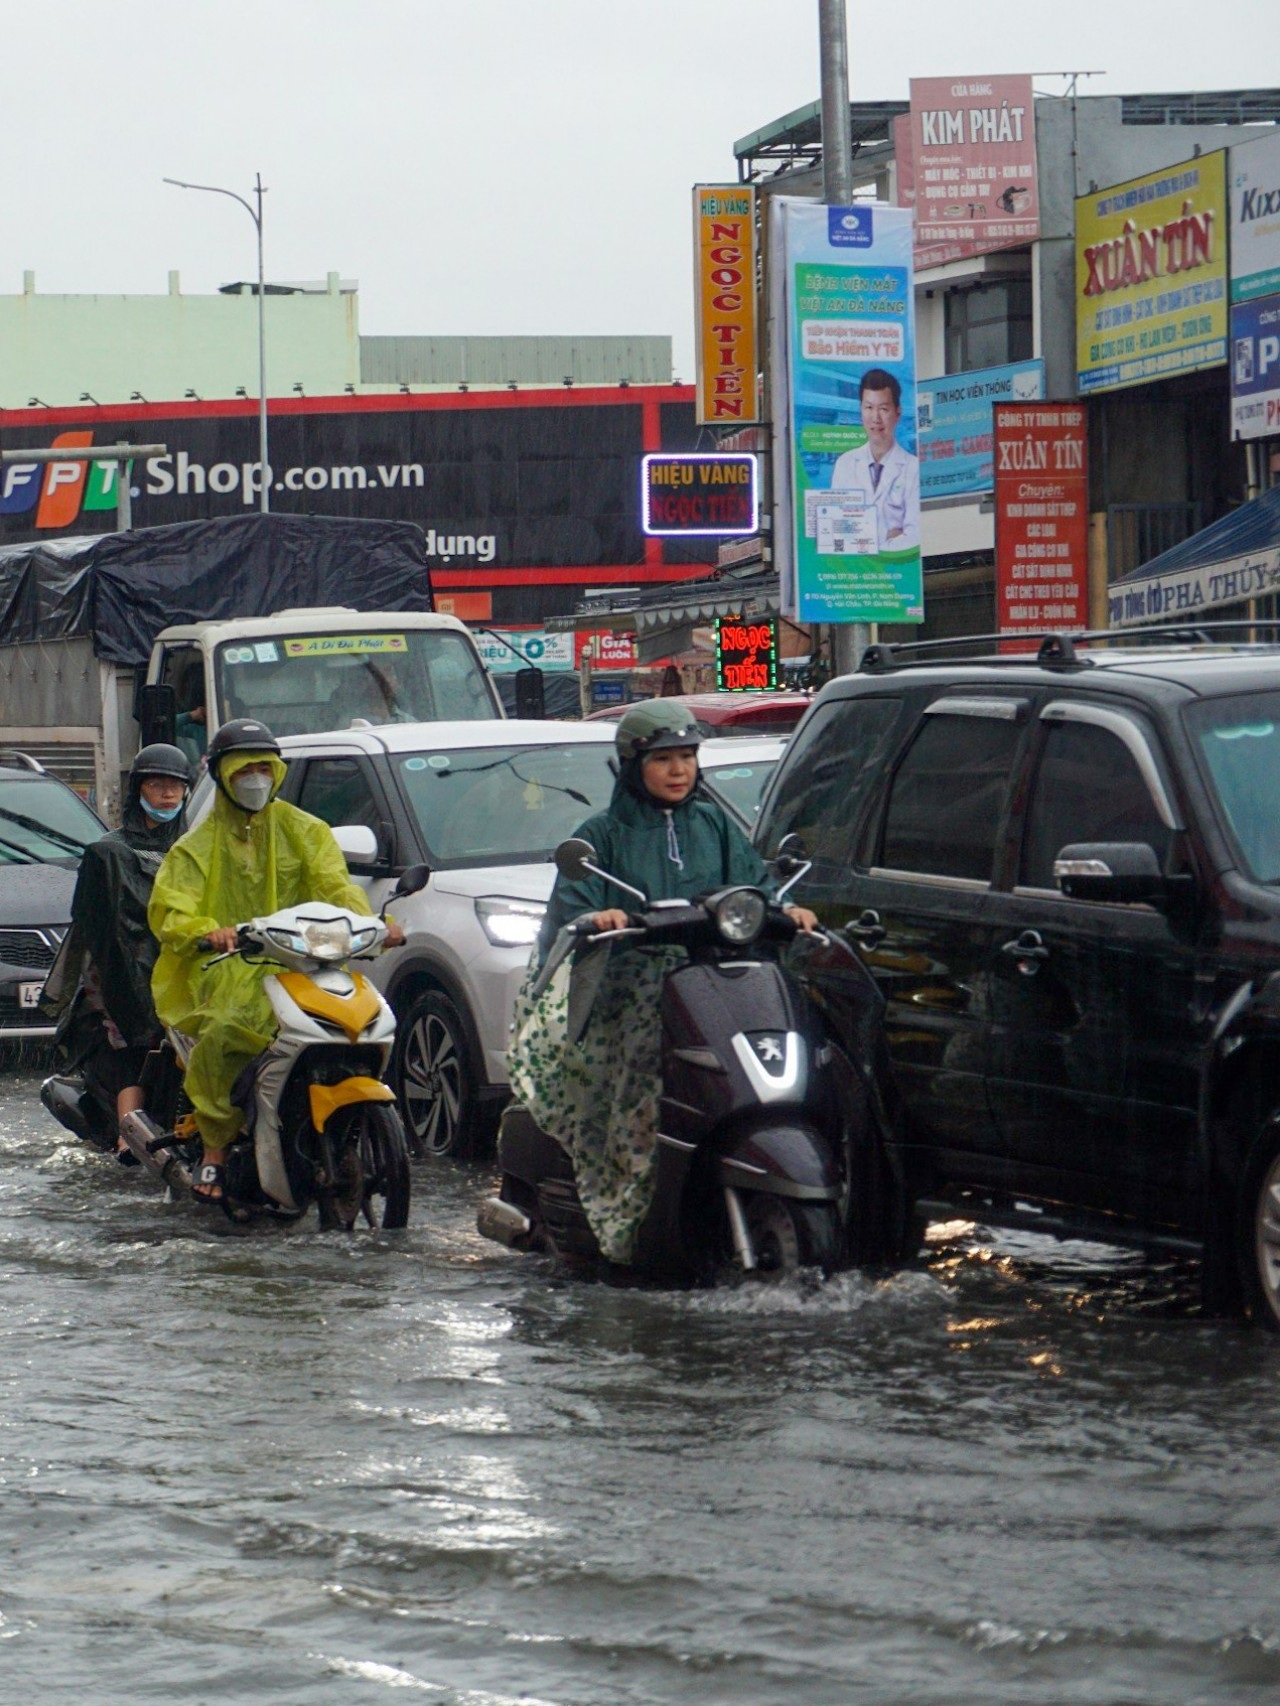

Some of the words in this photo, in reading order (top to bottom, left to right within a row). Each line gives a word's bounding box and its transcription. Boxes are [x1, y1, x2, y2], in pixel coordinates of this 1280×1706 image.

[921, 108, 965, 146] KIM
[968, 99, 1025, 144] PHÁT
[701, 195, 721, 221] HIỆU
[724, 194, 750, 217] VÀNG
[1083, 217, 1164, 297] XUÂN
[1162, 198, 1216, 275] TÍN
[709, 222, 743, 313] NGỌC
[805, 273, 838, 293] BỆNH
[842, 274, 869, 293] VIỆN
[872, 273, 898, 292] MẮT
[800, 296, 824, 314] VIỆT
[827, 300, 845, 311] AN
[848, 295, 865, 311] ĐÀ
[872, 342, 882, 357] Y
[712, 323, 745, 418] TIẾN
[936, 391, 948, 404] TIN
[998, 433, 1048, 470] XUÂN
[1052, 432, 1083, 470] TÍN
[3, 462, 119, 499] FPT
[651, 460, 694, 489] HIỆU
[699, 460, 750, 485] VÀNG
[1018, 482, 1065, 500] Chuyên:
[1163, 579, 1206, 612] PHA
[721, 625, 771, 655] NGỌC
[724, 656, 768, 689] TIẾN
